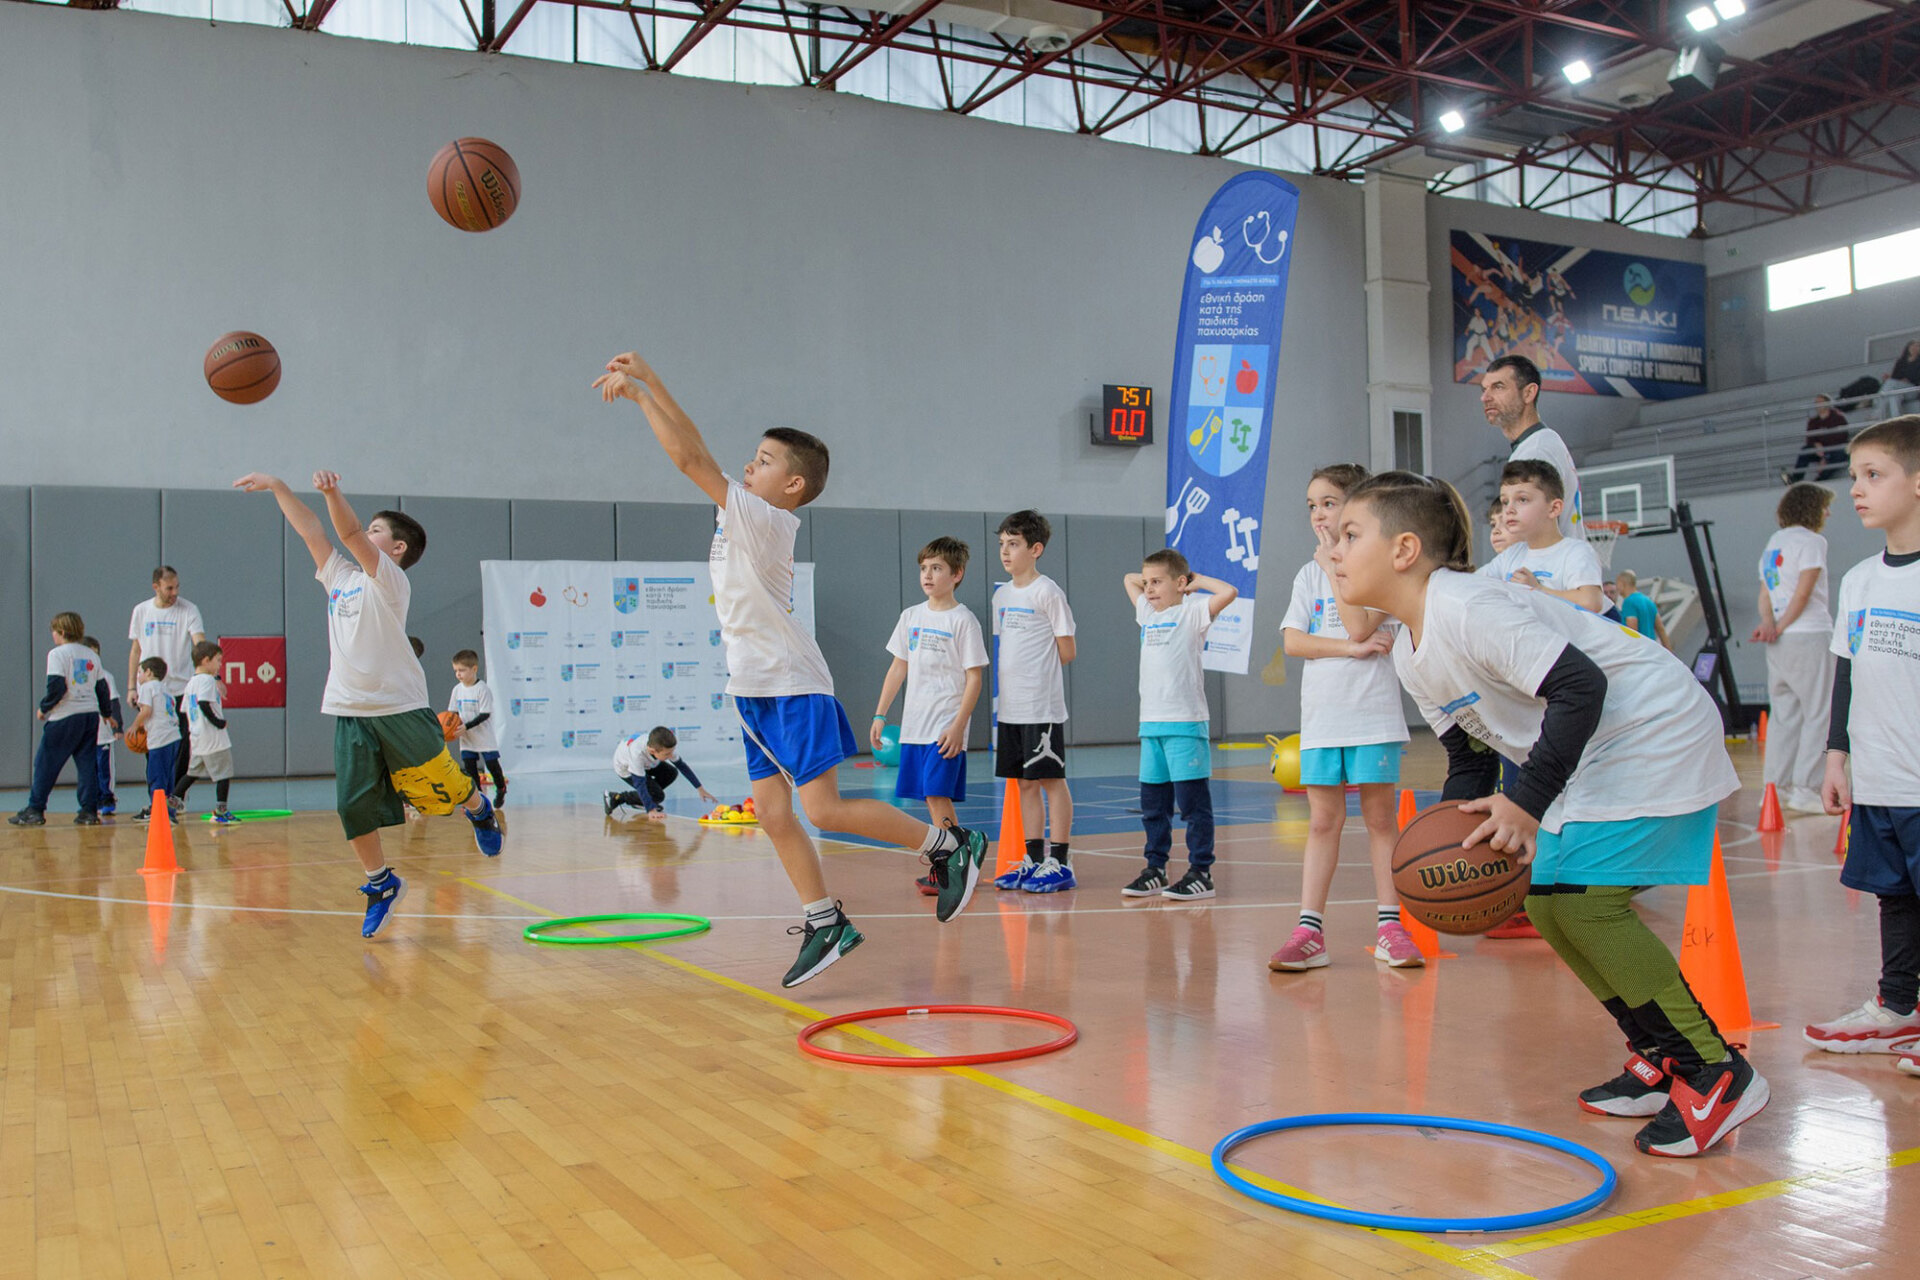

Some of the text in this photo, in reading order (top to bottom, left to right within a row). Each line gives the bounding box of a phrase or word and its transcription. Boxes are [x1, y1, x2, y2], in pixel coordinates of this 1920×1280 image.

[1200, 290, 1266, 306] εθνική δράση
[1199, 303, 1242, 315] κατά της
[1198, 315, 1239, 326] παιδικής
[1197, 324, 1260, 340] παχυσαρκίας
[1898, 622, 1920, 634] δράσ
[430, 781, 452, 803] 5
[1417, 858, 1510, 890] Wilson
[1631, 1061, 1657, 1080] NIKE
